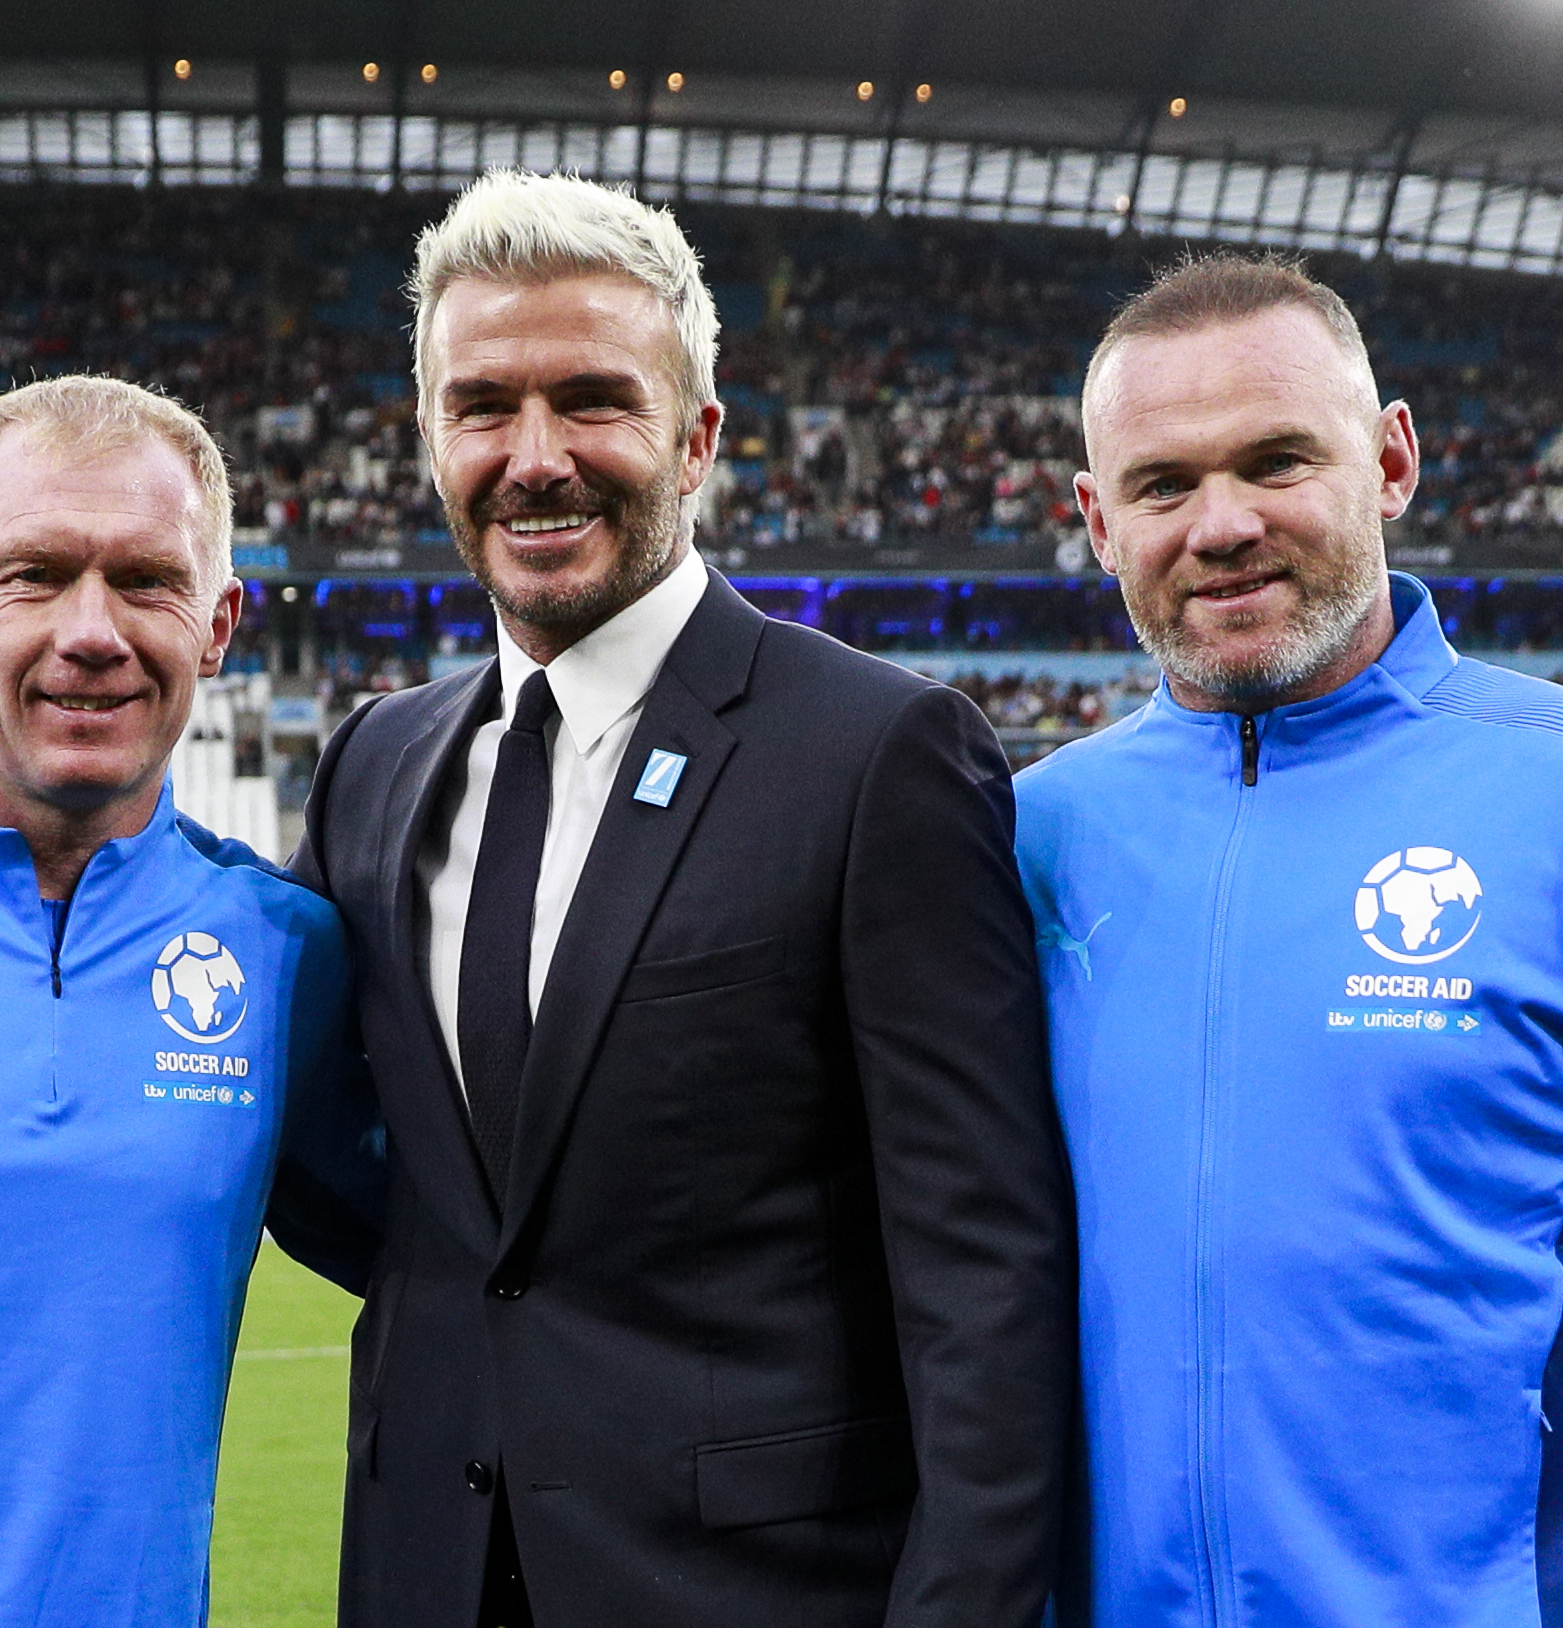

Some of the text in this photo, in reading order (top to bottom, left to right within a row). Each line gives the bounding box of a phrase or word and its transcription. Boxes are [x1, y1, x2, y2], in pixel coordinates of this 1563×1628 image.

[1345, 975, 1473, 1001] SOCCER AID
[1328, 1009, 1424, 1029] itv unicef
[155, 1052, 249, 1077] SOCCER AID
[144, 1084, 218, 1102] itv unicef
